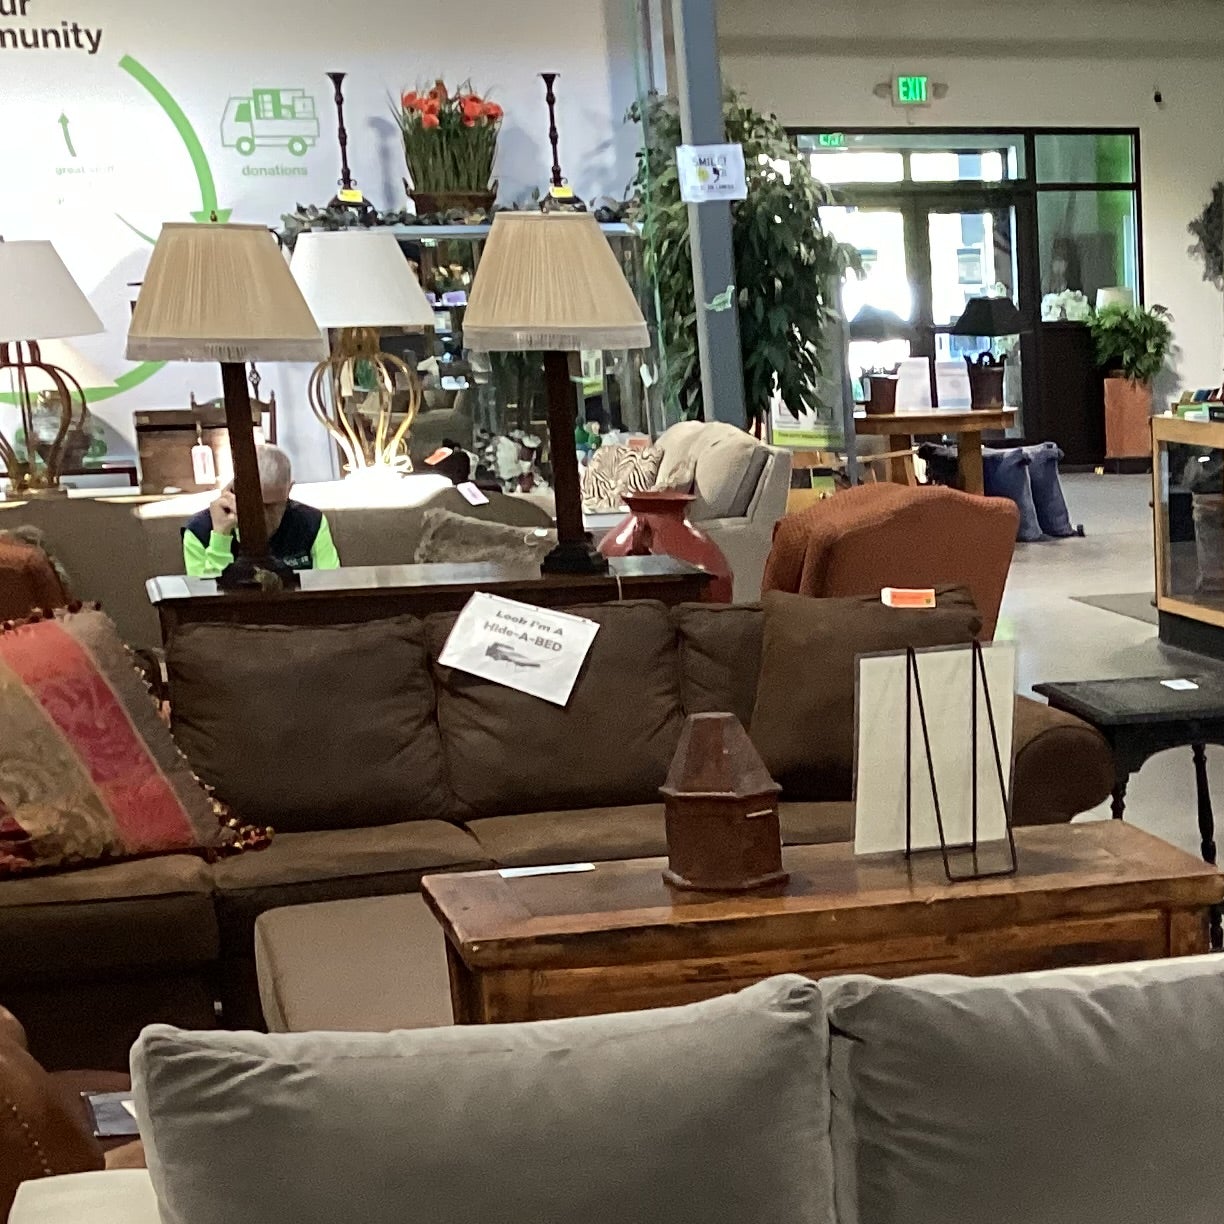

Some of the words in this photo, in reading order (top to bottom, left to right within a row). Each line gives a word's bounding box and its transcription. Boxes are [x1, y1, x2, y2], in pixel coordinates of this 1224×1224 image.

[898, 76, 928, 101] EXIT
[242, 164, 308, 177] donations
[484, 620, 563, 652] Hide-A-BED
[529, 620, 551, 633] I'm
[553, 627, 563, 637] A
